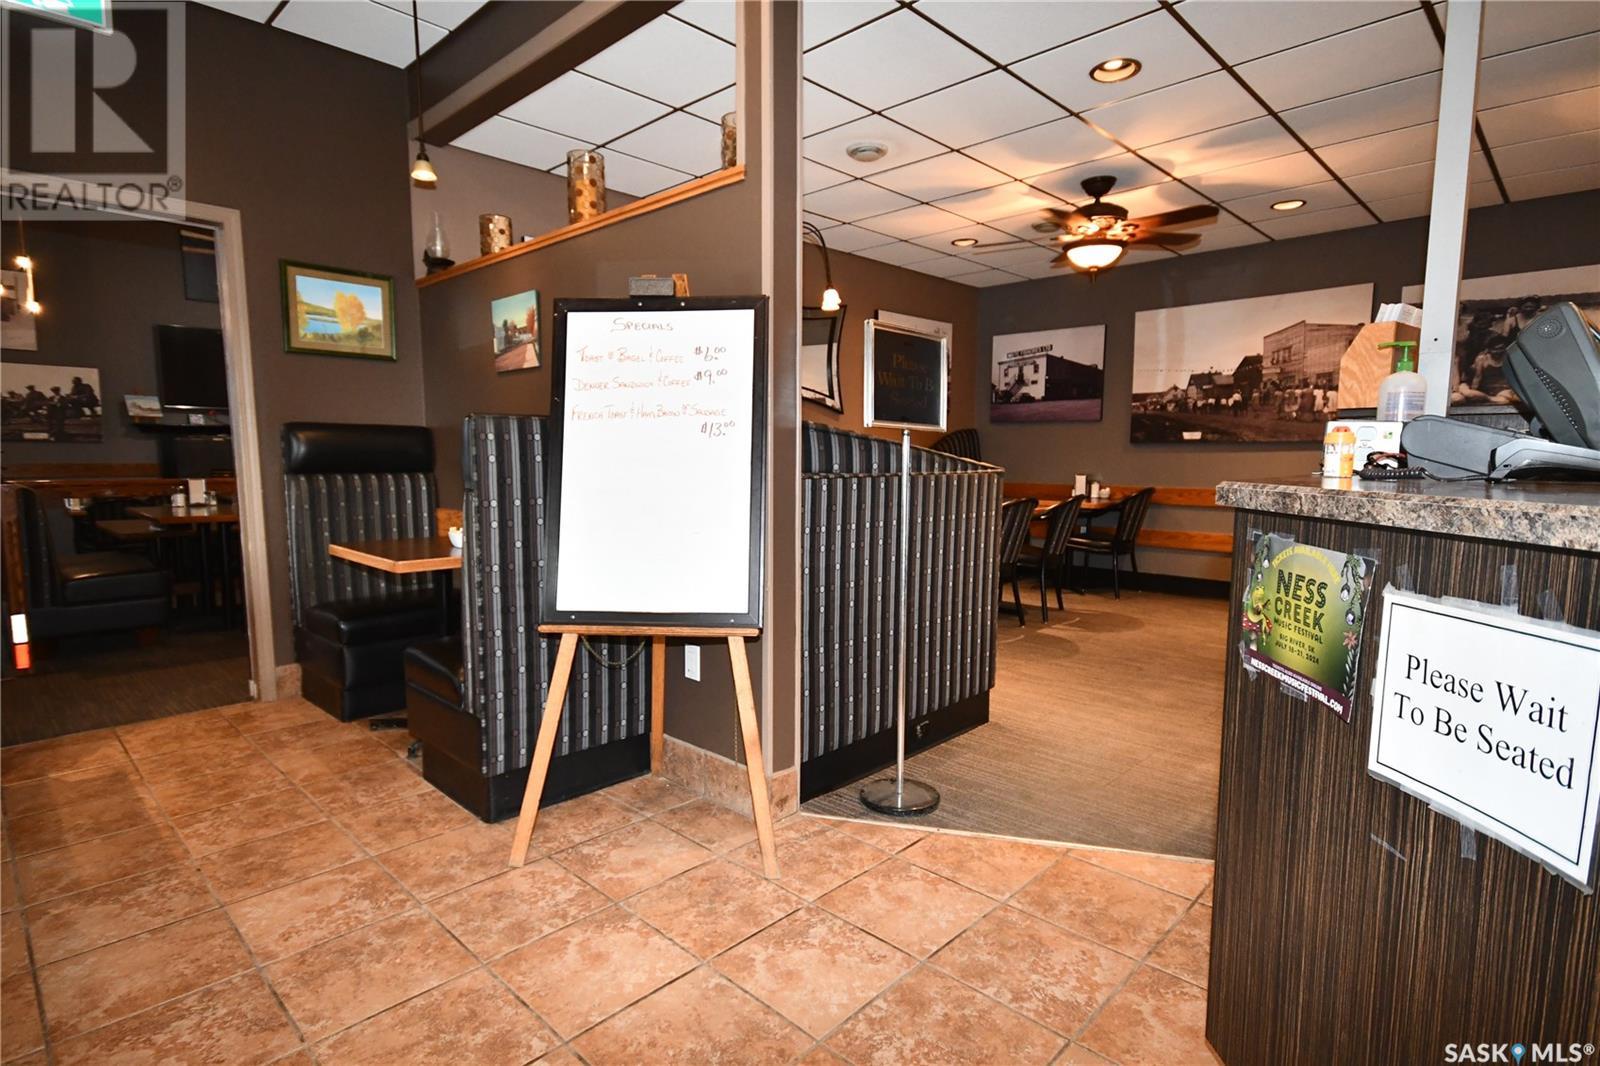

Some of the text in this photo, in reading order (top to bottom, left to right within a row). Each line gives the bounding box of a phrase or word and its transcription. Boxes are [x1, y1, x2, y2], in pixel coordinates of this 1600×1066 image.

[1276, 568, 1328, 609] NESS
[1274, 597, 1325, 633] CREEK
[1274, 616, 1323, 645] MUSIC FESTIVAL
[1405, 653, 1569, 733] Please Wait
[1393, 692, 1575, 790] To Be Seated
